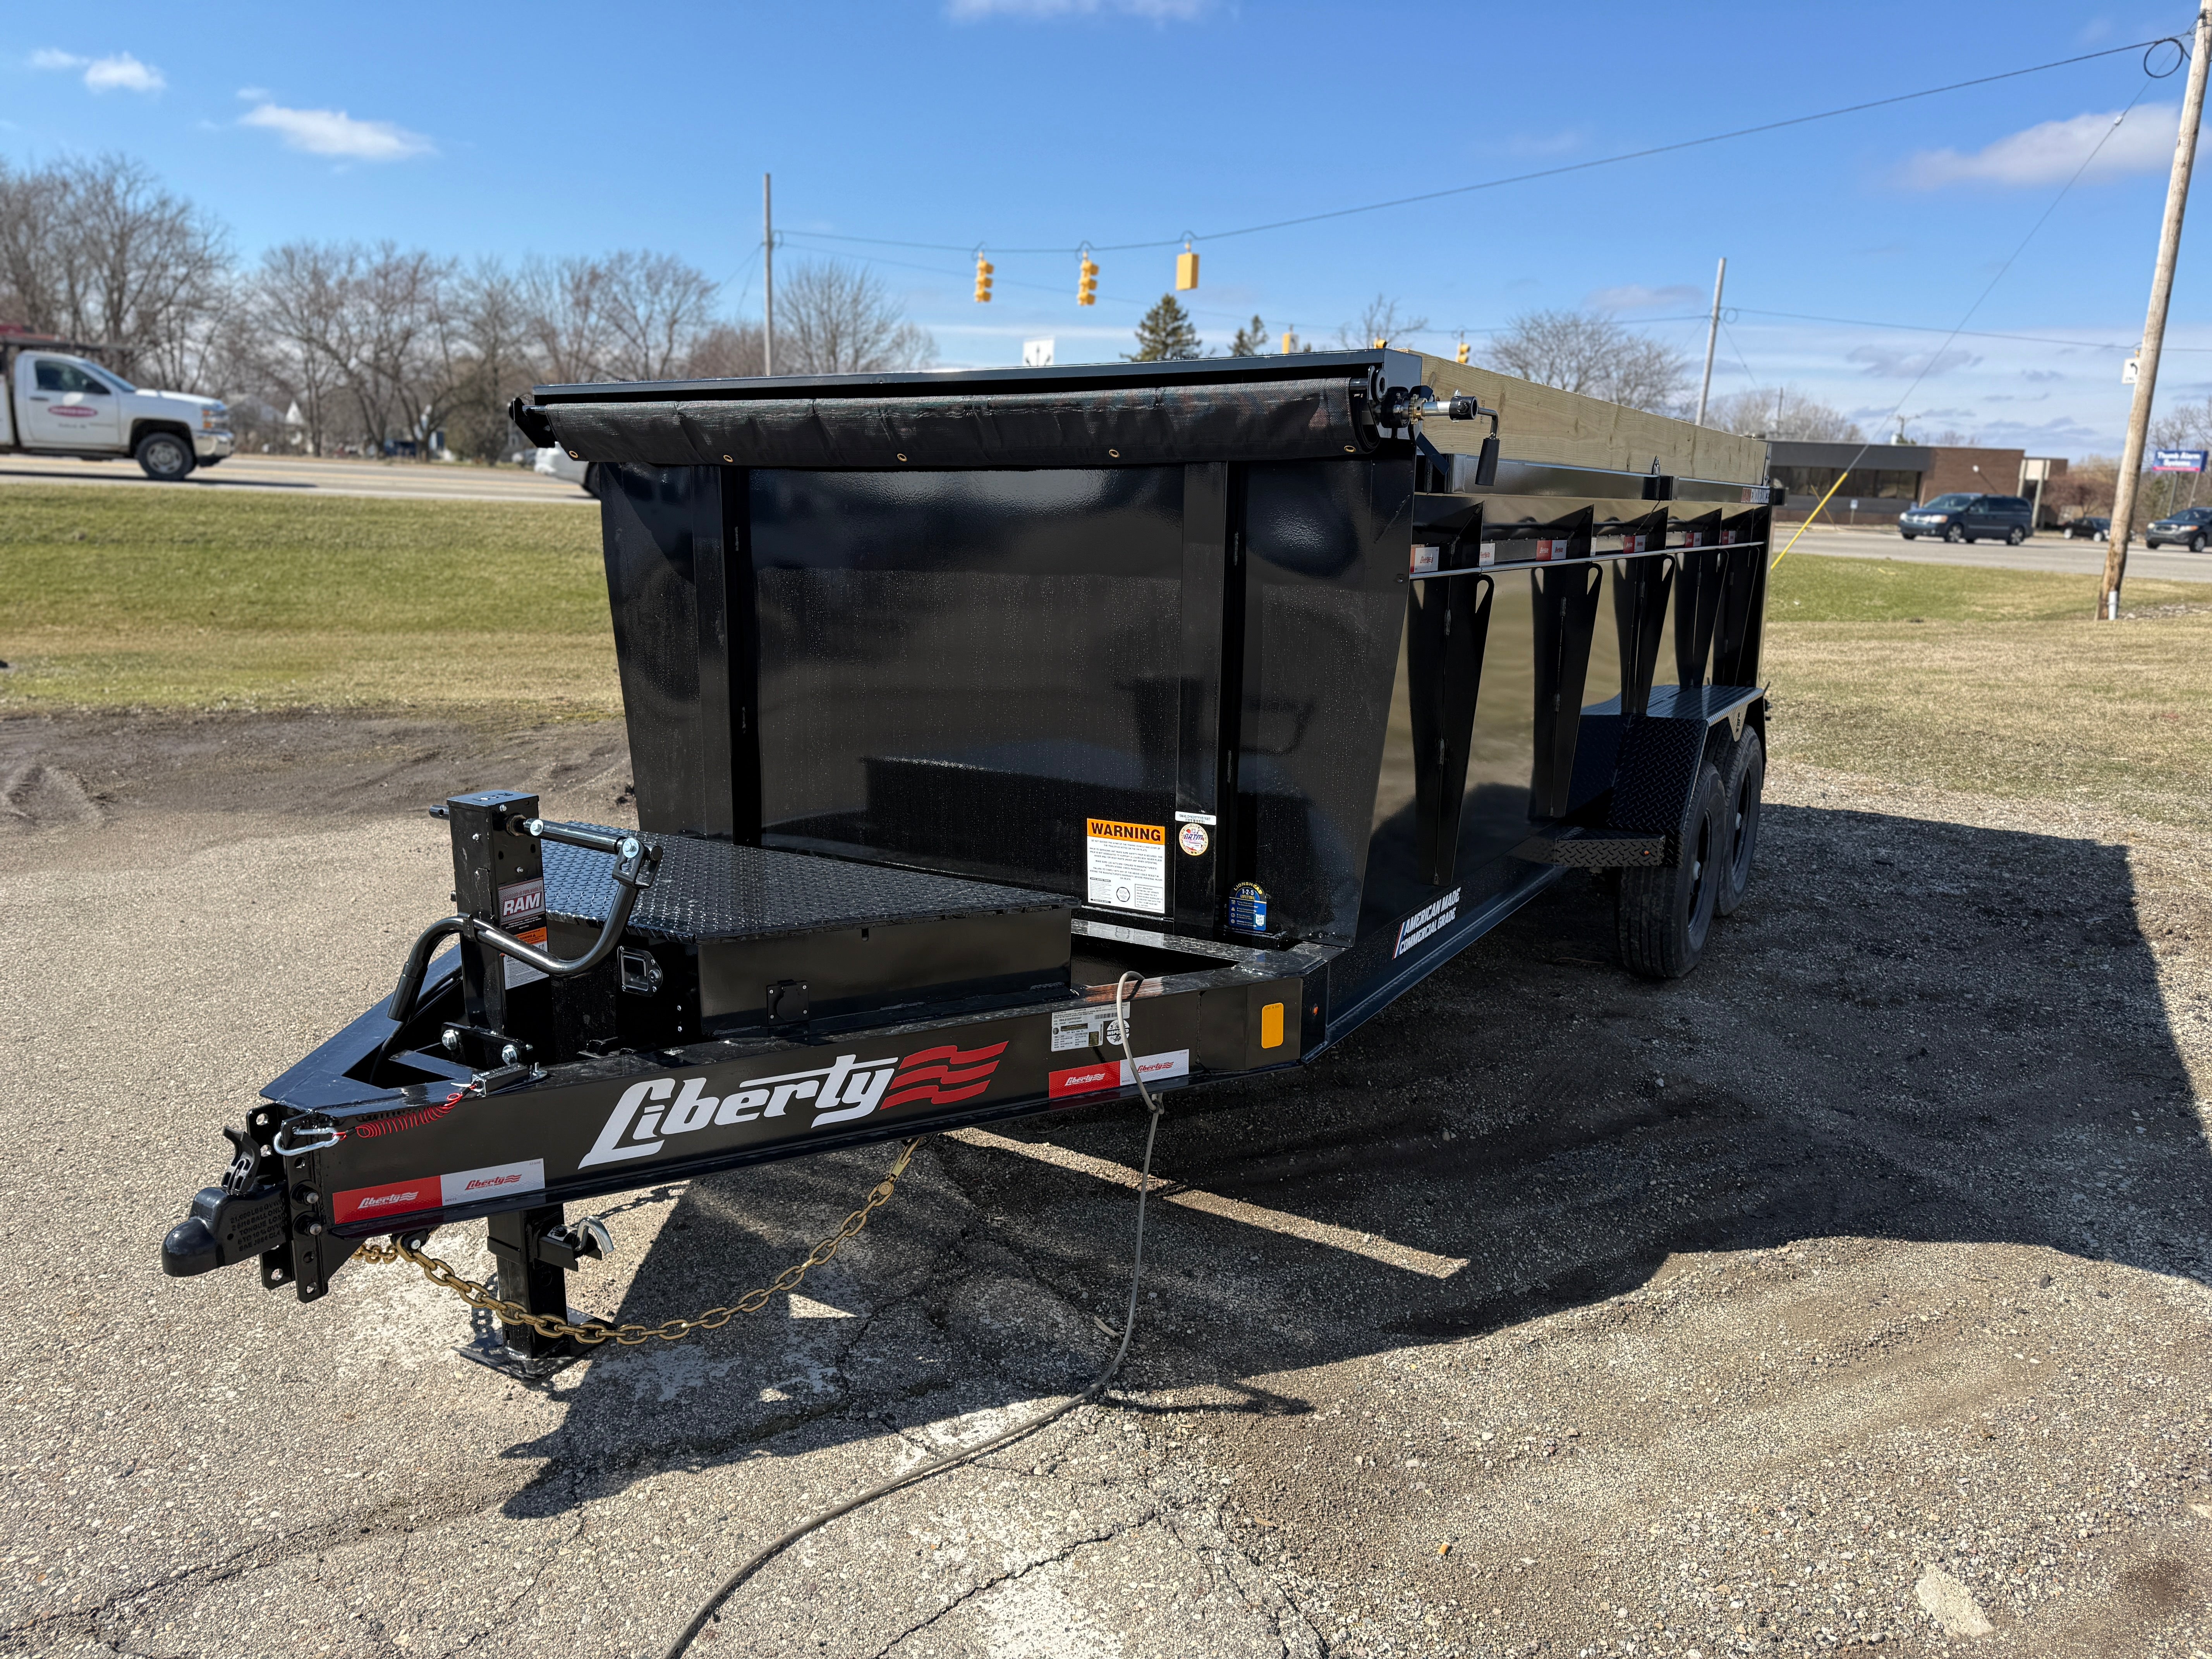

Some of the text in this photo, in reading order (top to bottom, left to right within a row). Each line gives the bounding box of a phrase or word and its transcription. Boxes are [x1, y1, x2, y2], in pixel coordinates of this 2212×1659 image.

[1091, 822, 1161, 842] WARNING
[1234, 882, 1263, 895] LIONSHEAD
[503, 892, 541, 916] RAM
[1404, 887, 1461, 936] AMERICAN MADE
[1399, 907, 1456, 955] COMMERCIAL GRADE
[1137, 1063, 1163, 1073] Liberty
[1065, 1073, 1094, 1087] Liberty
[577, 1054, 899, 1170] Liberty
[464, 1176, 506, 1191] Liberty
[357, 1194, 401, 1209] Liberty
[239, 1212, 287, 1235] TONGUE LOAD
